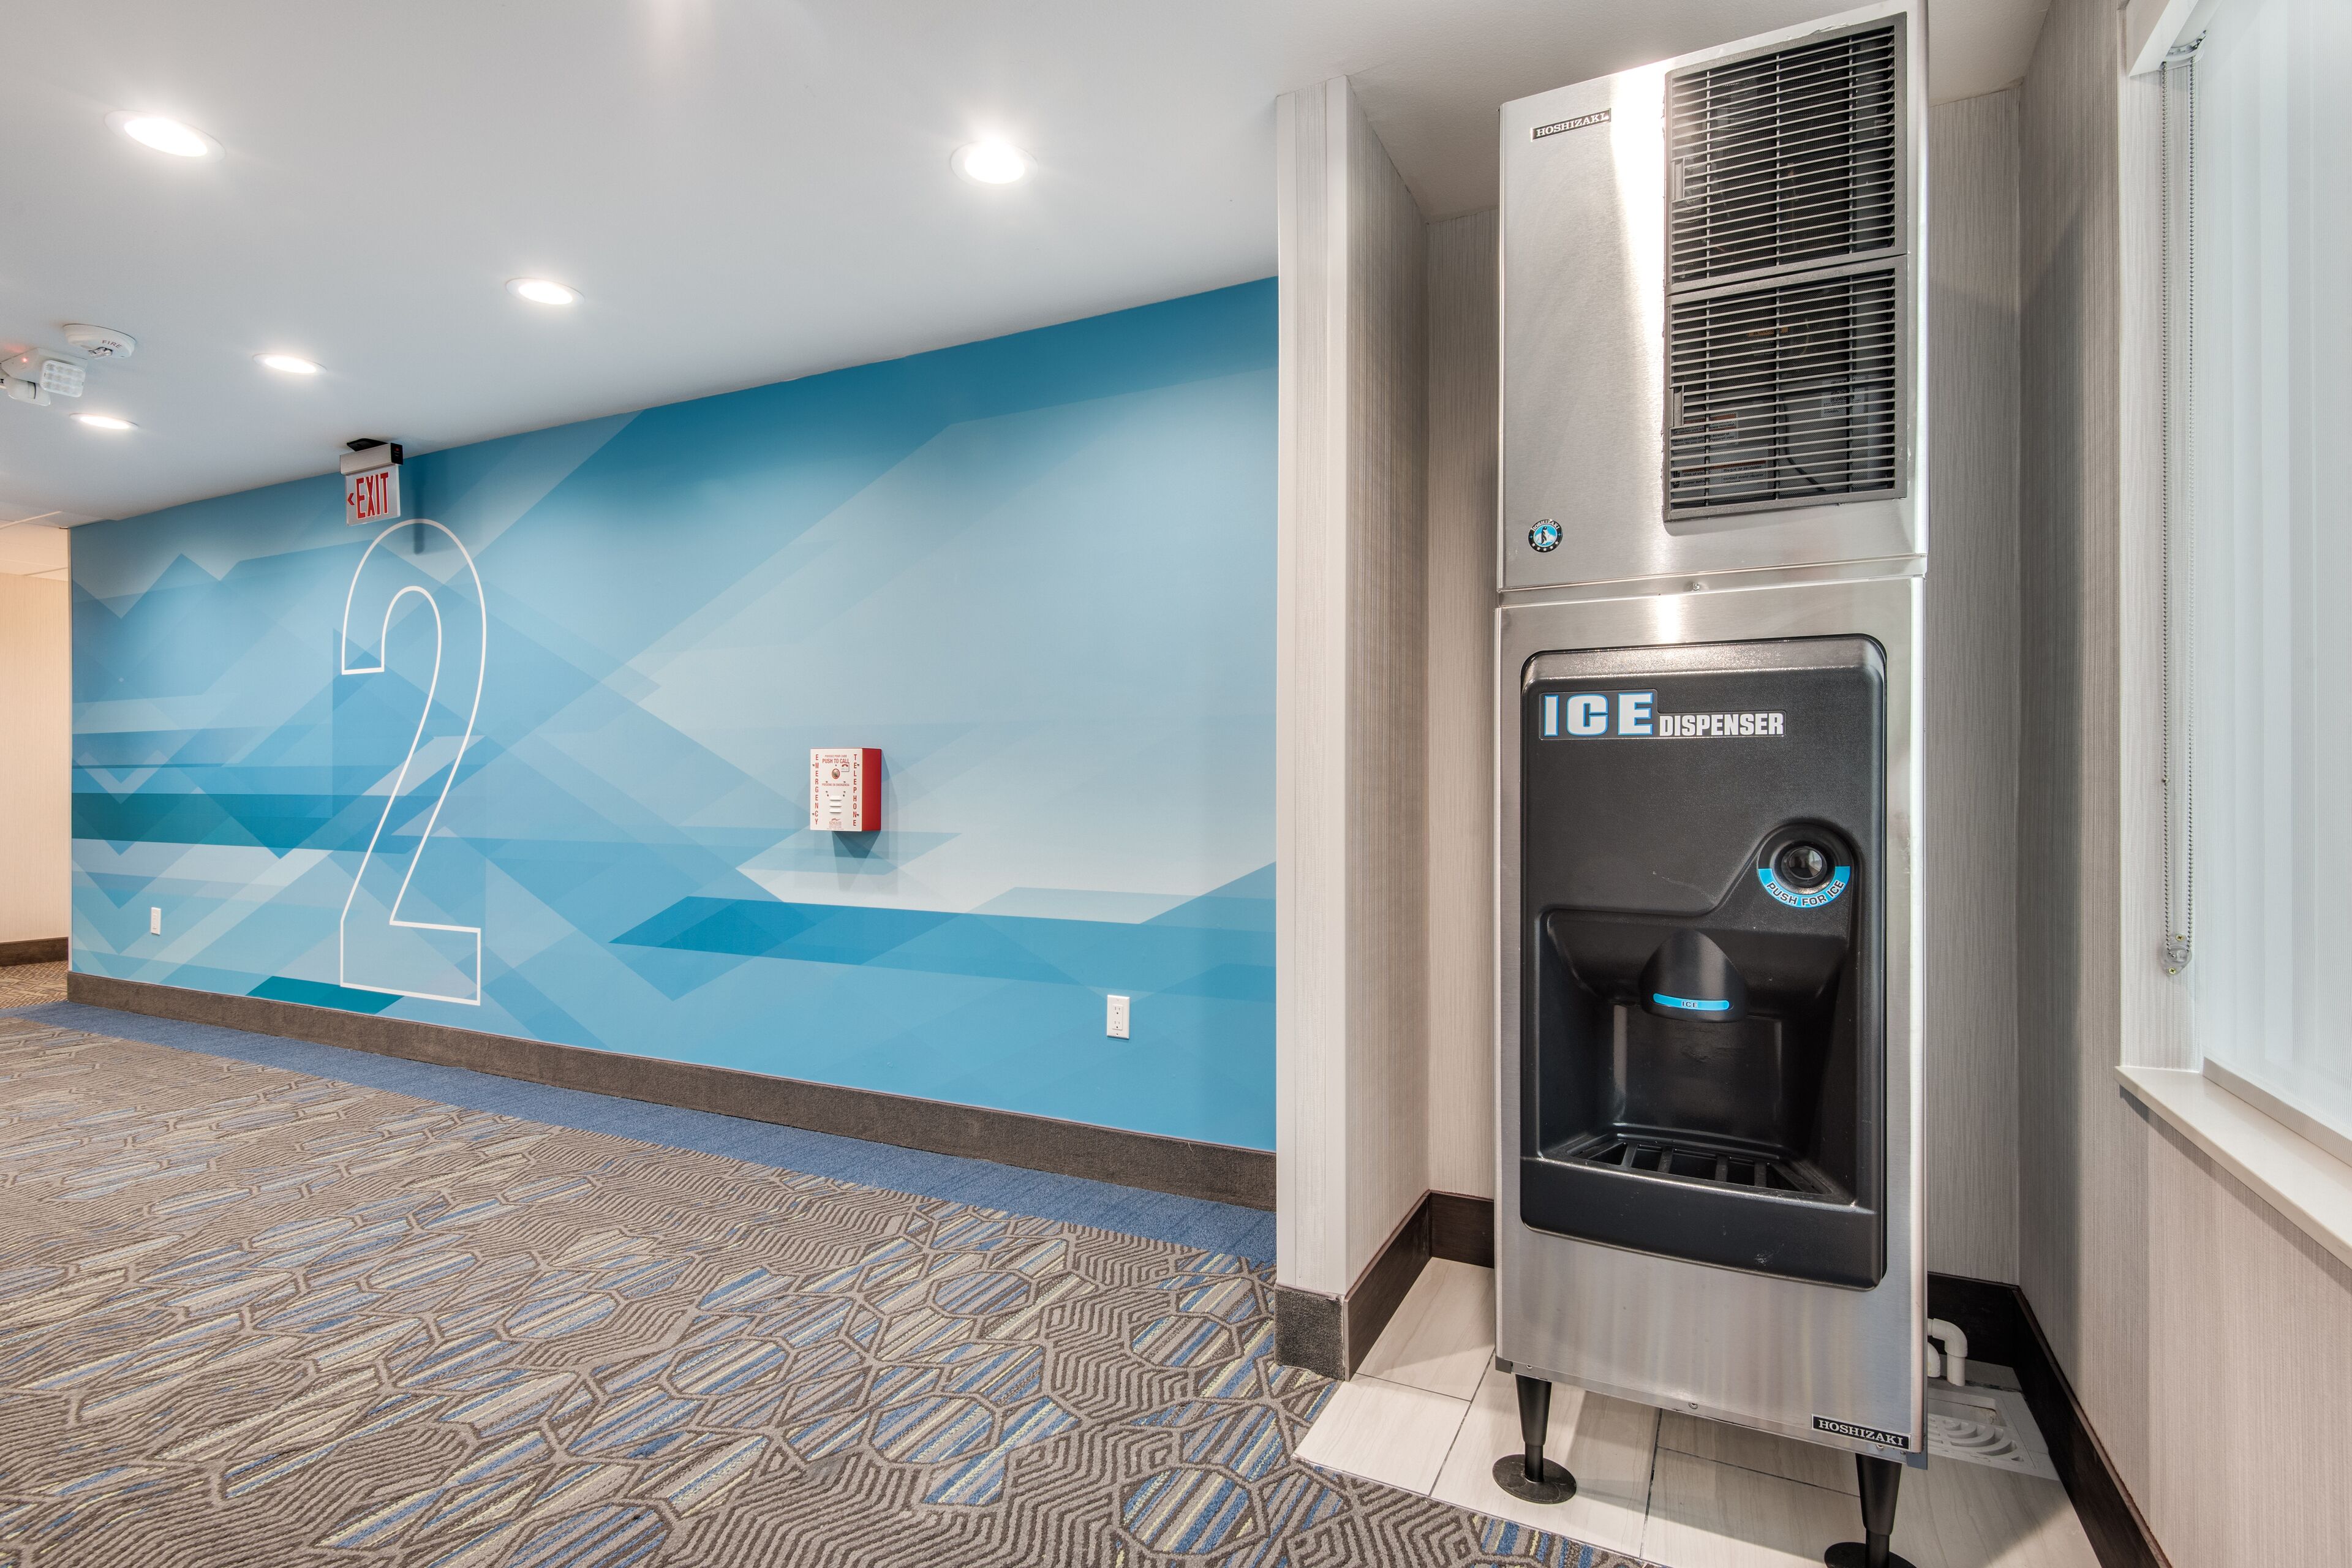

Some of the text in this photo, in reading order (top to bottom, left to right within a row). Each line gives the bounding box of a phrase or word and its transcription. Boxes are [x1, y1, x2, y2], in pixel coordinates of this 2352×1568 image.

[1536, 113, 1609, 137] HOSHIZAKI
[102, 339, 123, 349] FIRE
[356, 472, 389, 519] EXIT
[1531, 519, 1560, 532] HOSHIZAKI
[1544, 692, 1784, 737] ICE DISPENSER
[340, 518, 487, 1006] 2
[1766, 880, 1845, 906] PUSH FOR ICE
[1819, 1419, 1904, 1446] HOSHIZAKI
